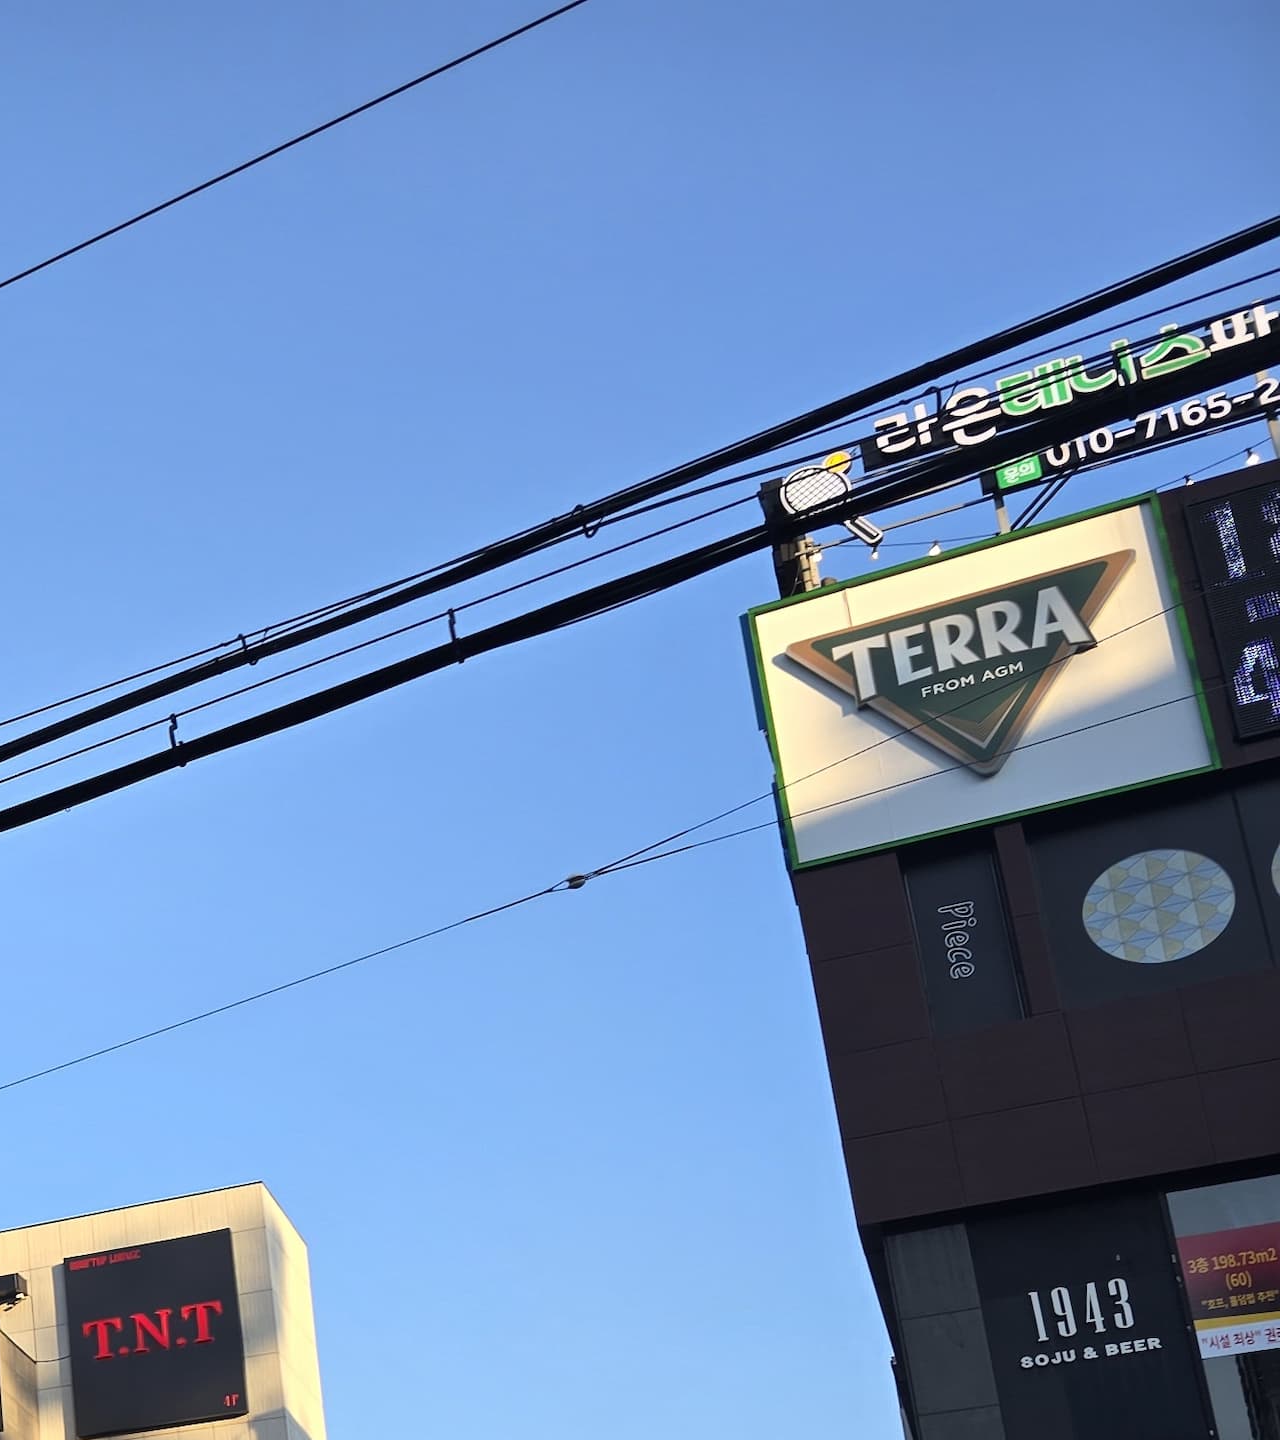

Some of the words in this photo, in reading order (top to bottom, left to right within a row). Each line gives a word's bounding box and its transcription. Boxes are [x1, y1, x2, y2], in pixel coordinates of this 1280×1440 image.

[832, 586, 1098, 709] TERRA
[921, 674, 975, 698] FROM
[981, 661, 1024, 687] AGM
[1187, 1257, 1209, 1274] 3층
[1213, 1247, 1278, 1271] 198.73m2
[1225, 1271, 1252, 1291] (60)
[1028, 1277, 1136, 1343] 1943
[81, 1299, 224, 1361] T.N.T
[1020, 1348, 1077, 1370] SOJU
[1082, 1346, 1099, 1361] &
[1105, 1336, 1163, 1357] BEER
